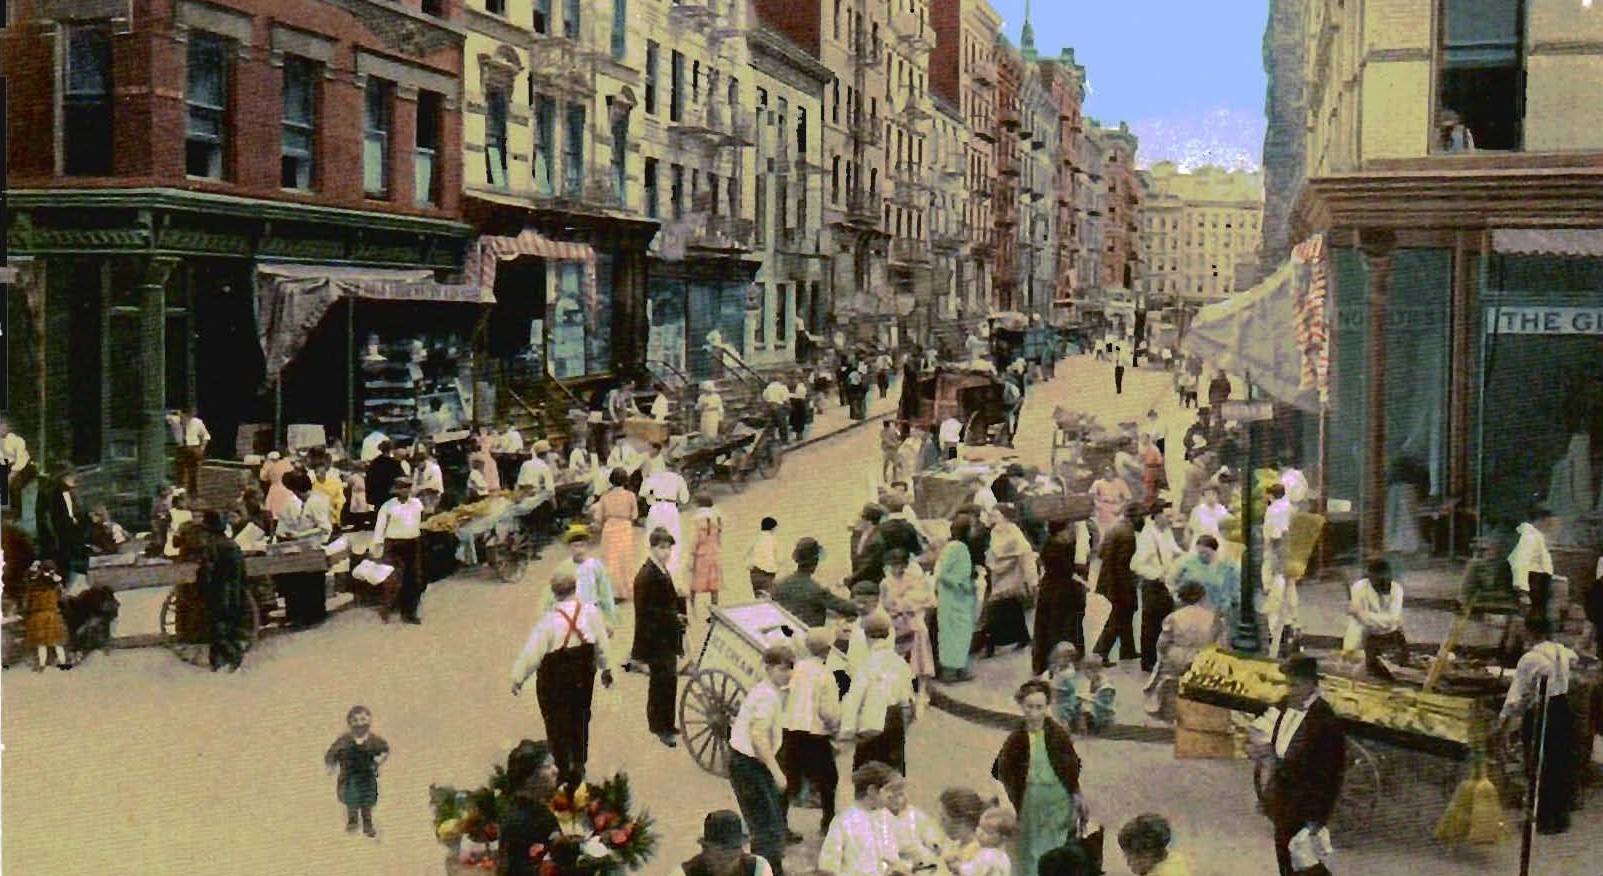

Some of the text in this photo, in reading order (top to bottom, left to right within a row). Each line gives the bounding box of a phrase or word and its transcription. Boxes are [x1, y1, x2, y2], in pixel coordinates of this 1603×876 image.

[1501, 312, 1561, 331] THE
[710, 636, 756, 677] ICE CREAM
